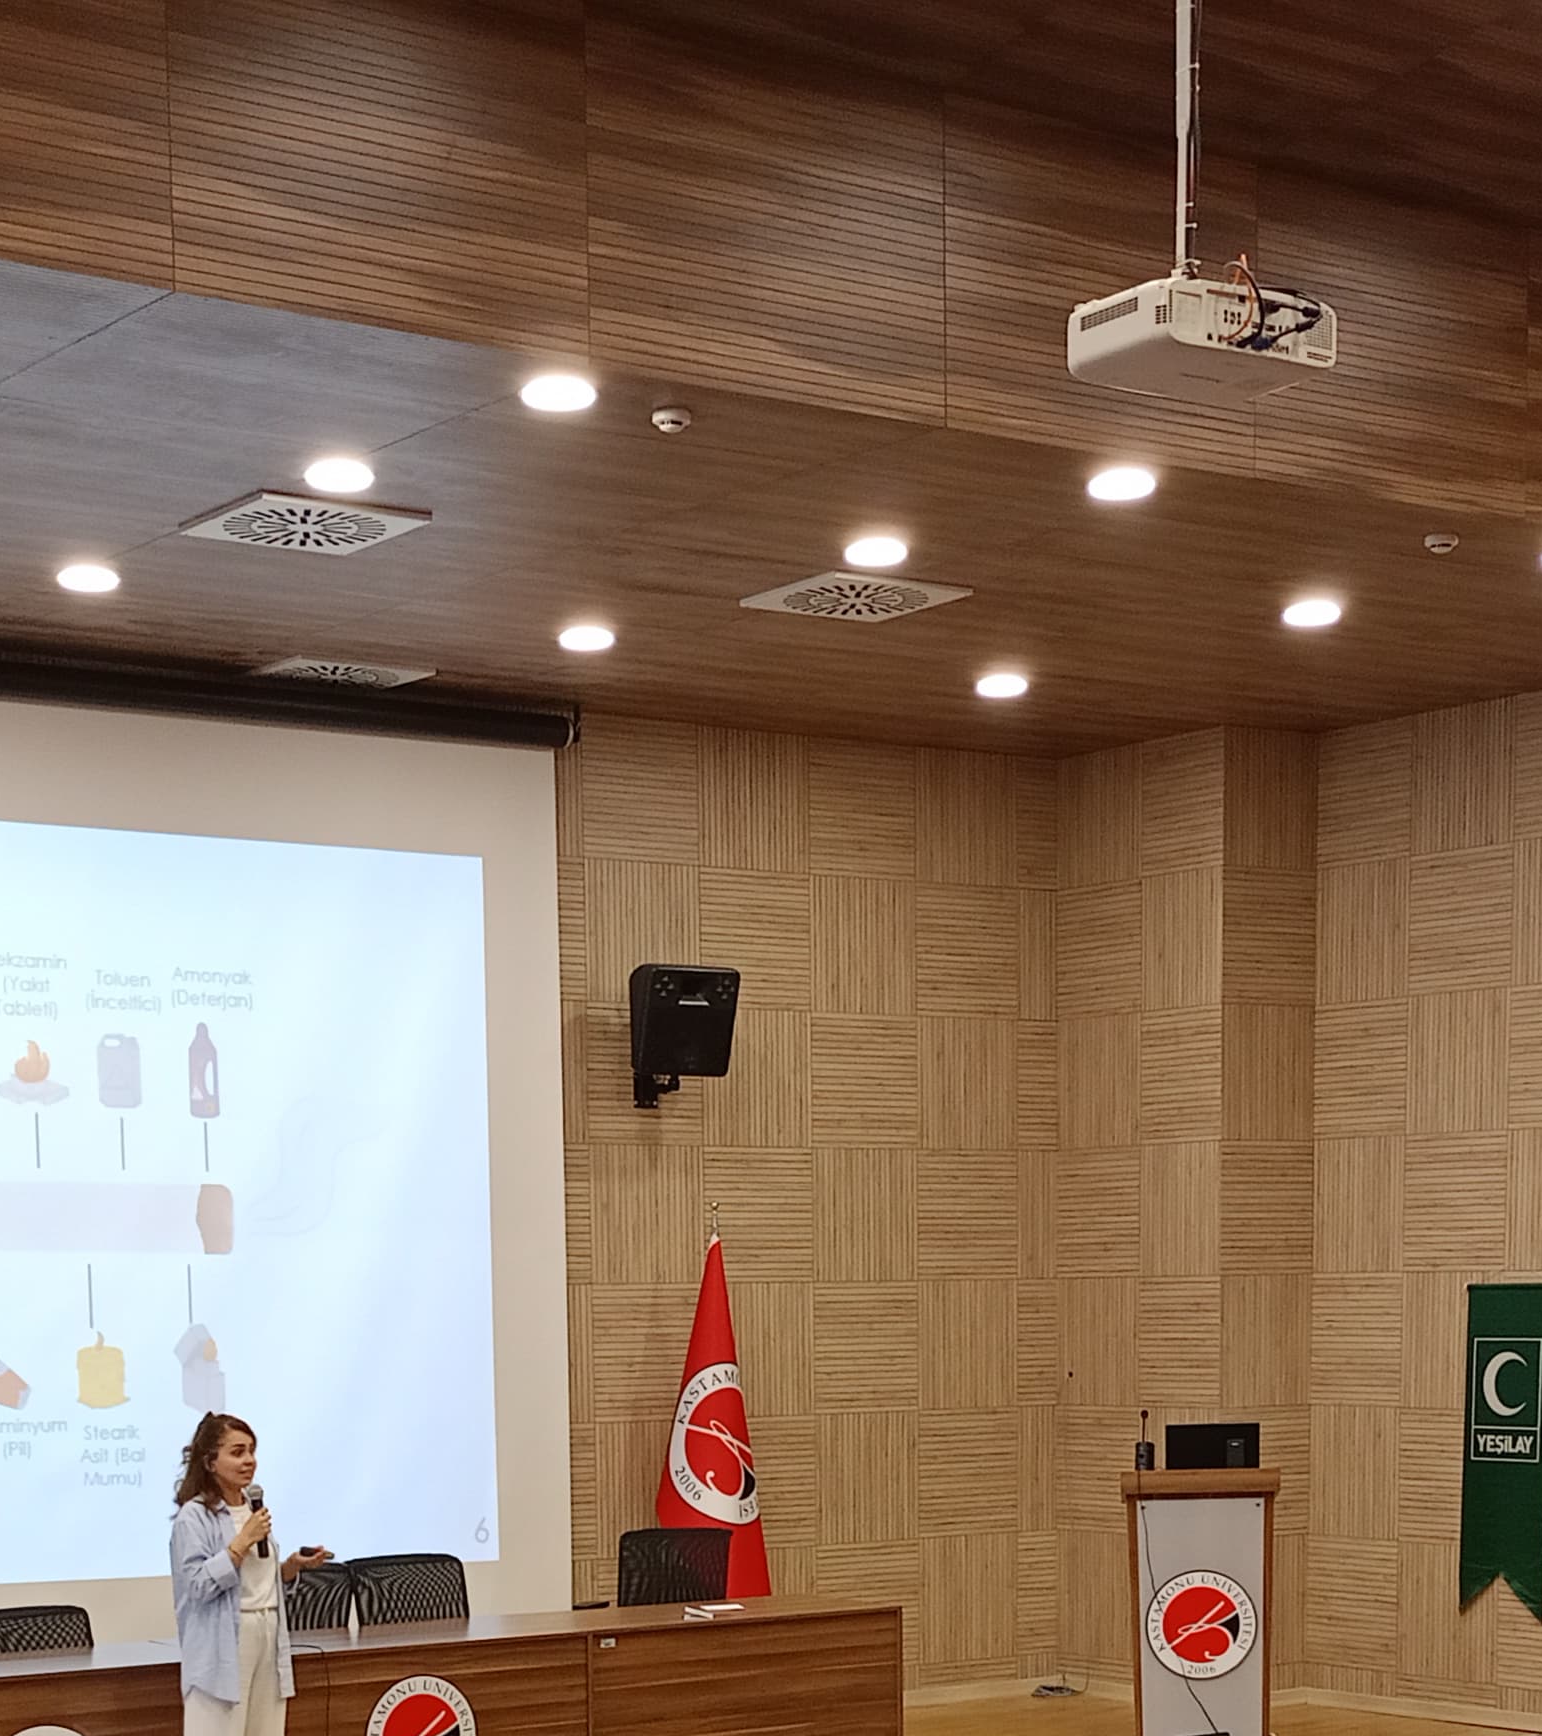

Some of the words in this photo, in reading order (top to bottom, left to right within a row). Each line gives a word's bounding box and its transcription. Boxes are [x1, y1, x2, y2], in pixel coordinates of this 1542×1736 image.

[94, 969, 152, 987] Toluen
[172, 966, 253, 988] Amonyak
[172, 989, 254, 1012] (Deterjan)
[83, 1424, 140, 1441] Stearik
[84, 1470, 143, 1488] Mumu)
[675, 1465, 702, 1501] 2006
[474, 1517, 490, 1544] 6
[1187, 1665, 1216, 1674] 2006
